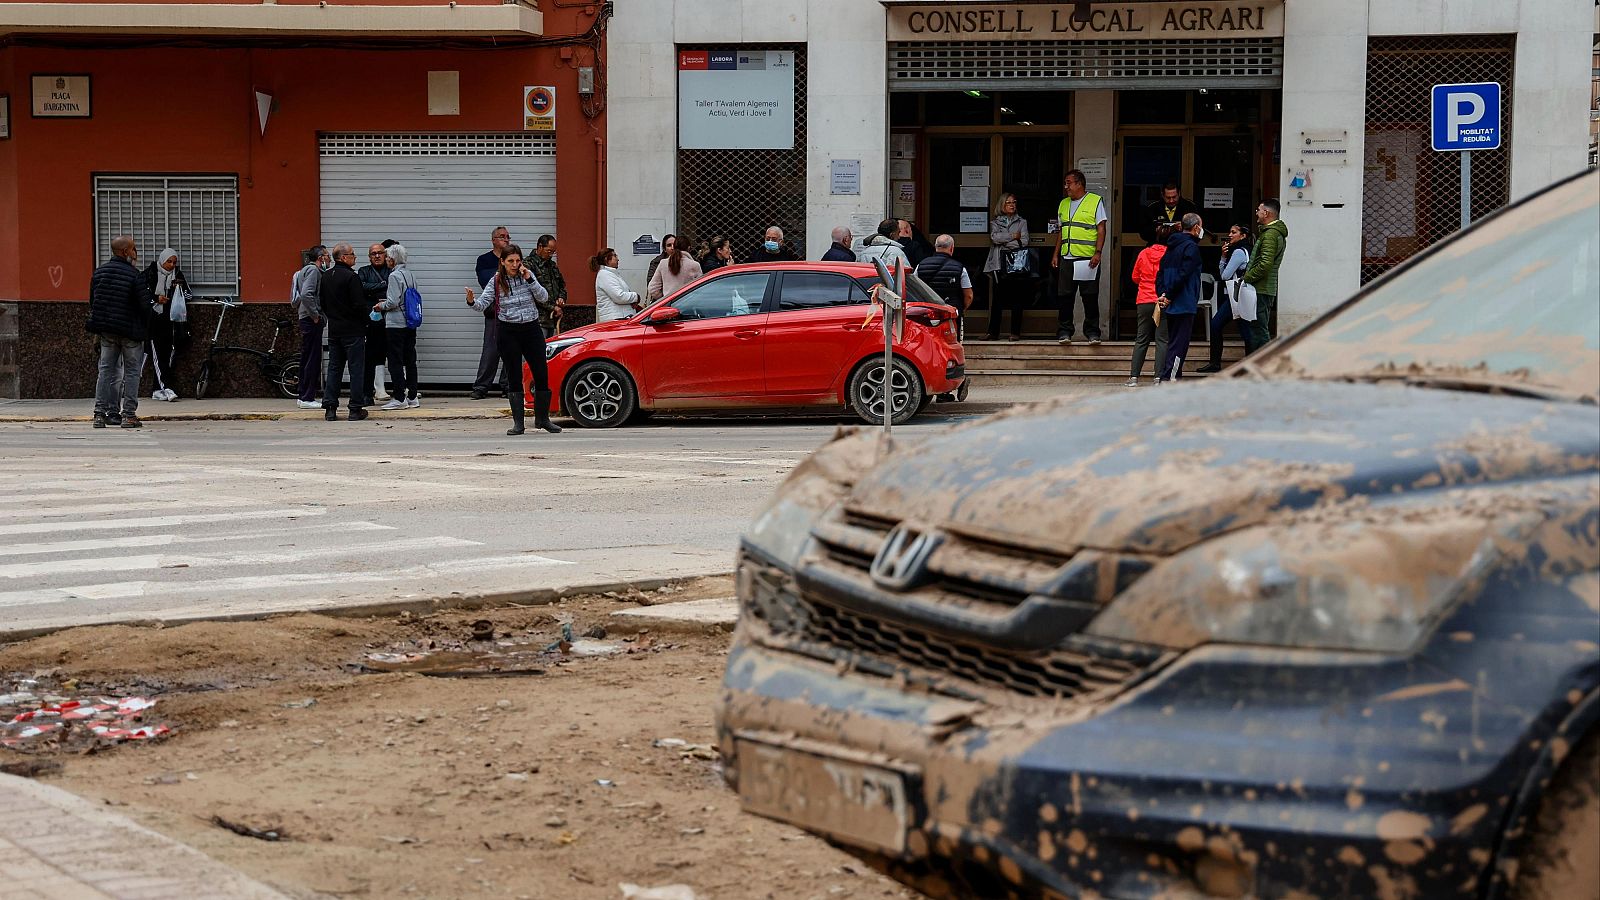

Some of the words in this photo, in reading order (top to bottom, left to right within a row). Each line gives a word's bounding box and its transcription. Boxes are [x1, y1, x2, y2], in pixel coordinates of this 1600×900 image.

[908, 10, 1033, 33] CONSELL
[1161, 7, 1265, 31] AGRARI
[51, 92, 71, 100] PLAÇA
[43, 102, 80, 111] D'ARGENTINA
[1447, 92, 1486, 142] P
